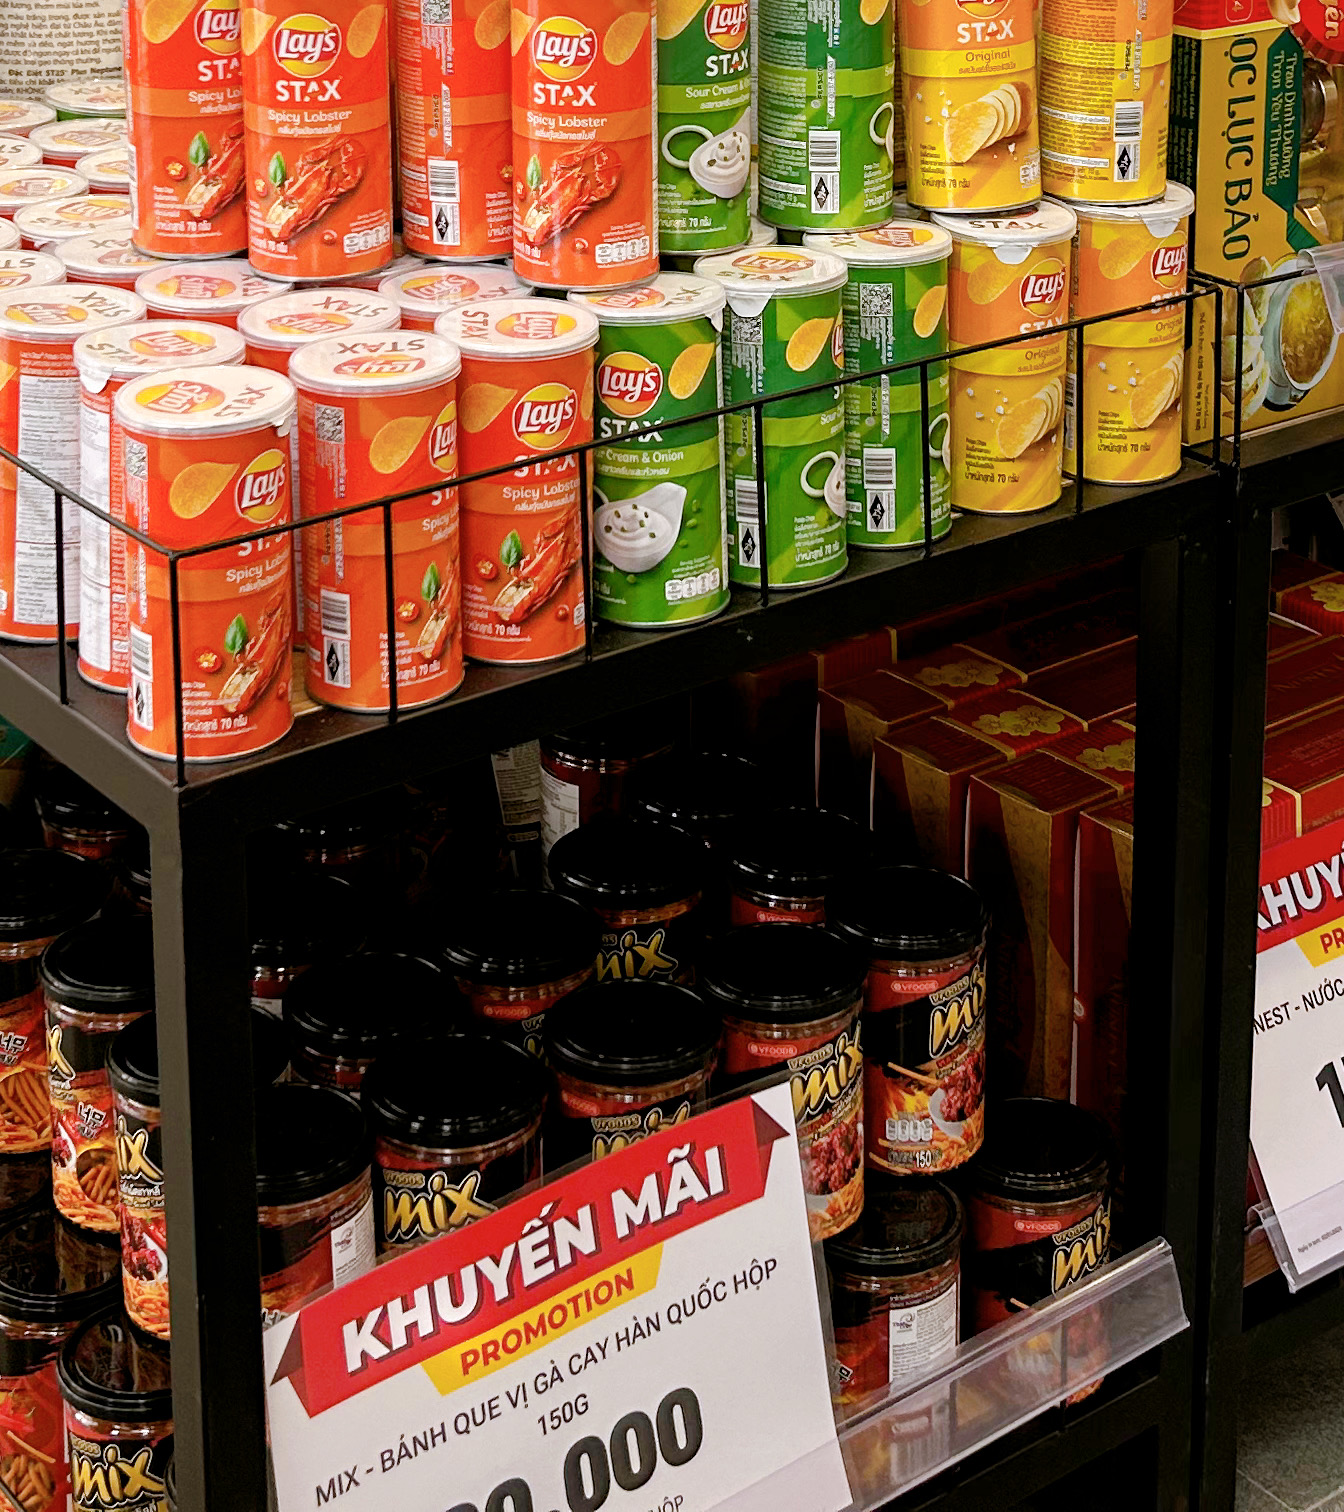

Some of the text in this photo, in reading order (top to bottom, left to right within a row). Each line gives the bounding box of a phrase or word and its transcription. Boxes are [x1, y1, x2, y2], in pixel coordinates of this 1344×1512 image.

[276, 28, 340, 64] Lay's
[268, 109, 352, 126] Spicy Lobster
[276, 80, 341, 102] STAX
[1223, 98, 1253, 260] LỤC BẢO
[343, 1142, 724, 1374] KHUYẾN MÃI
[460, 1268, 635, 1377] PROMOTION
[315, 1259, 777, 1507] MIX BÁNH QUE VỊ GÀ CAY HÀN QUỐC HỘP
[538, 1395, 590, 1435] 150G
